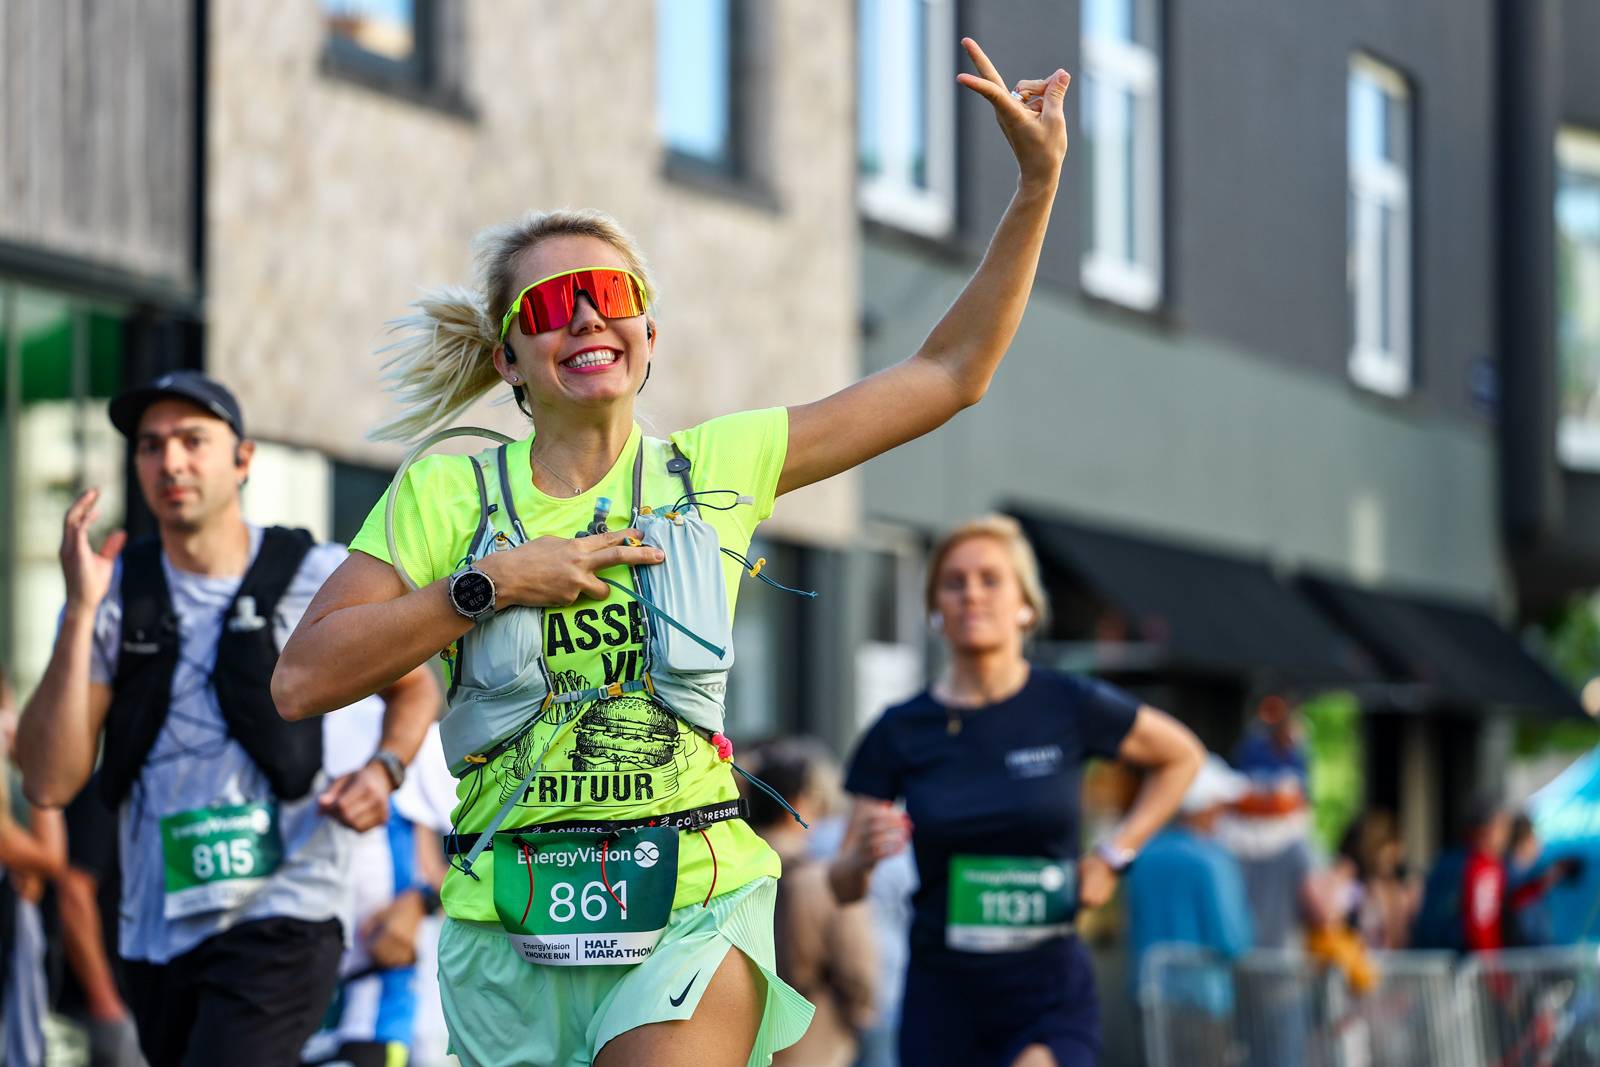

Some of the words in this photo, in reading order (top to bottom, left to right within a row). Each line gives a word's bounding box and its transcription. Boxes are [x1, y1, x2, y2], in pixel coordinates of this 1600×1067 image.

[522, 773, 654, 803] FRITUUR
[192, 838, 254, 879] 815
[517, 847, 631, 867] EnergyVision
[549, 880, 627, 922] 861
[980, 891, 1046, 923] 1131
[523, 942, 570, 951] EnergyVision
[585, 940, 618, 949] HALF
[585, 946, 653, 959] MARATHON
[524, 951, 553, 960] KNOKKE
[554, 952, 570, 960] RUN
